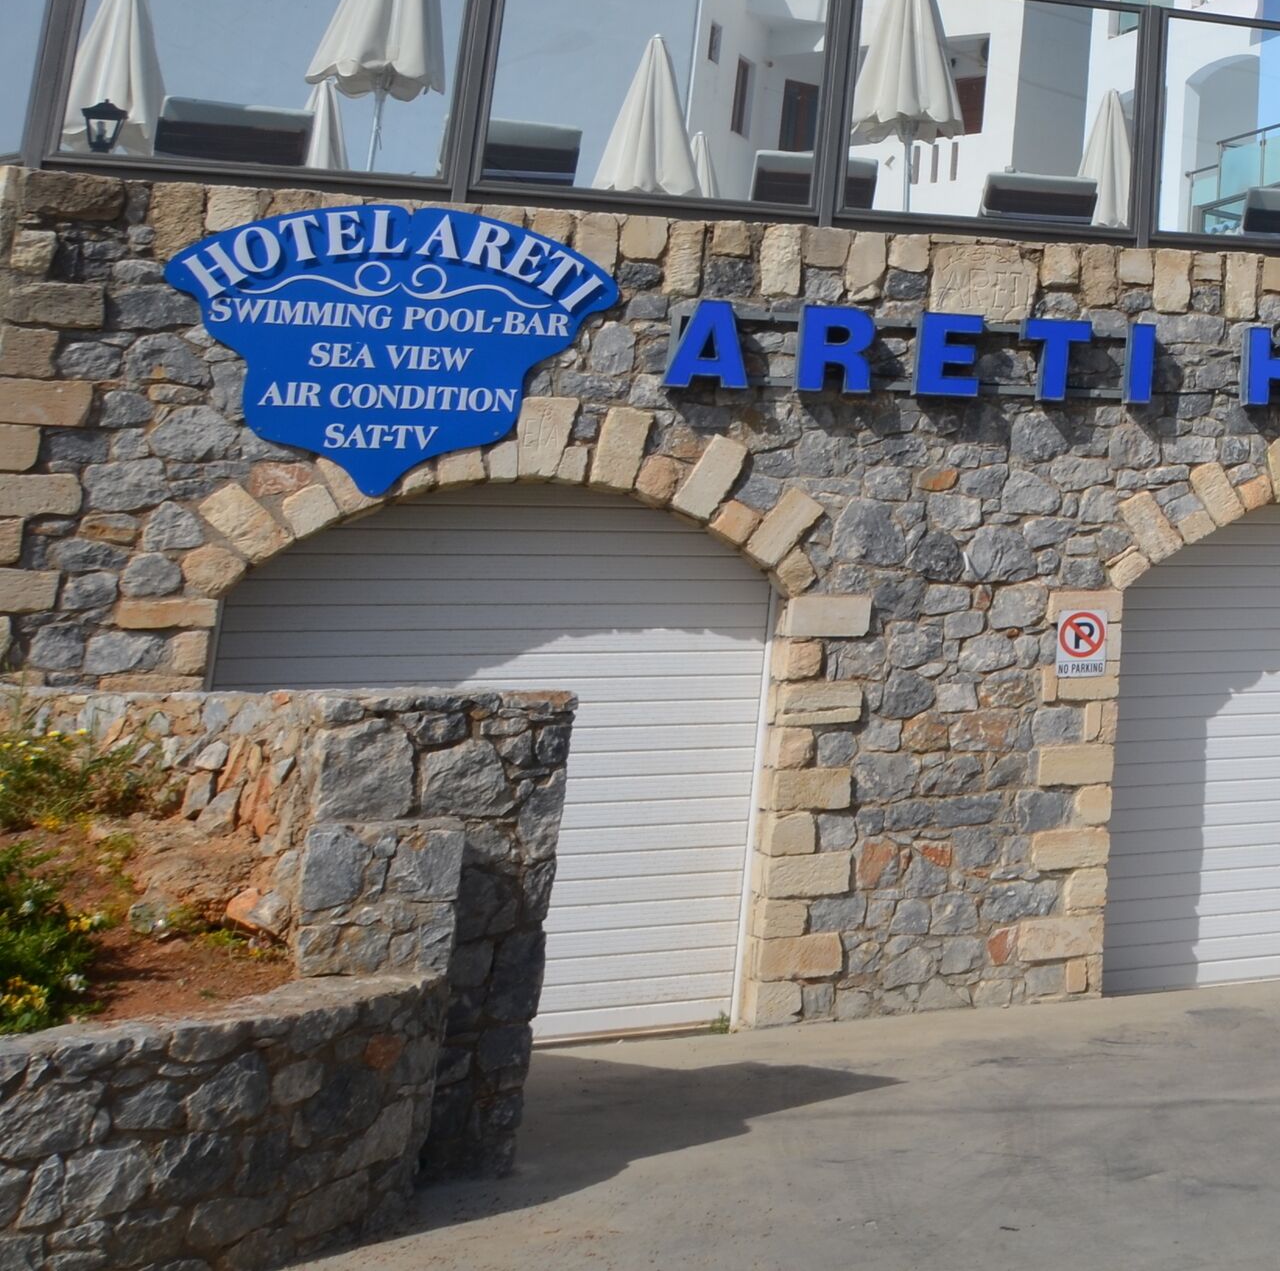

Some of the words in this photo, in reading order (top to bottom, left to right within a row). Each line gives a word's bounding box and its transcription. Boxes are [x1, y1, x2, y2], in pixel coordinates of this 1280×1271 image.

[182, 209, 408, 299] HOTEL
[416, 214, 604, 313] ARETI
[209, 297, 393, 330] SWIMMING
[402, 306, 569, 337] POOL-BAR
[308, 342, 376, 369] SEA
[386, 344, 474, 372] VIEW
[660, 299, 1158, 404] ARETI
[257, 381, 322, 408] AIR
[330, 383, 518, 413] CONDITION
[323, 423, 439, 450] SAT-TV
[1057, 663, 1069, 674] NO
[1071, 662, 1104, 673] PARKING
